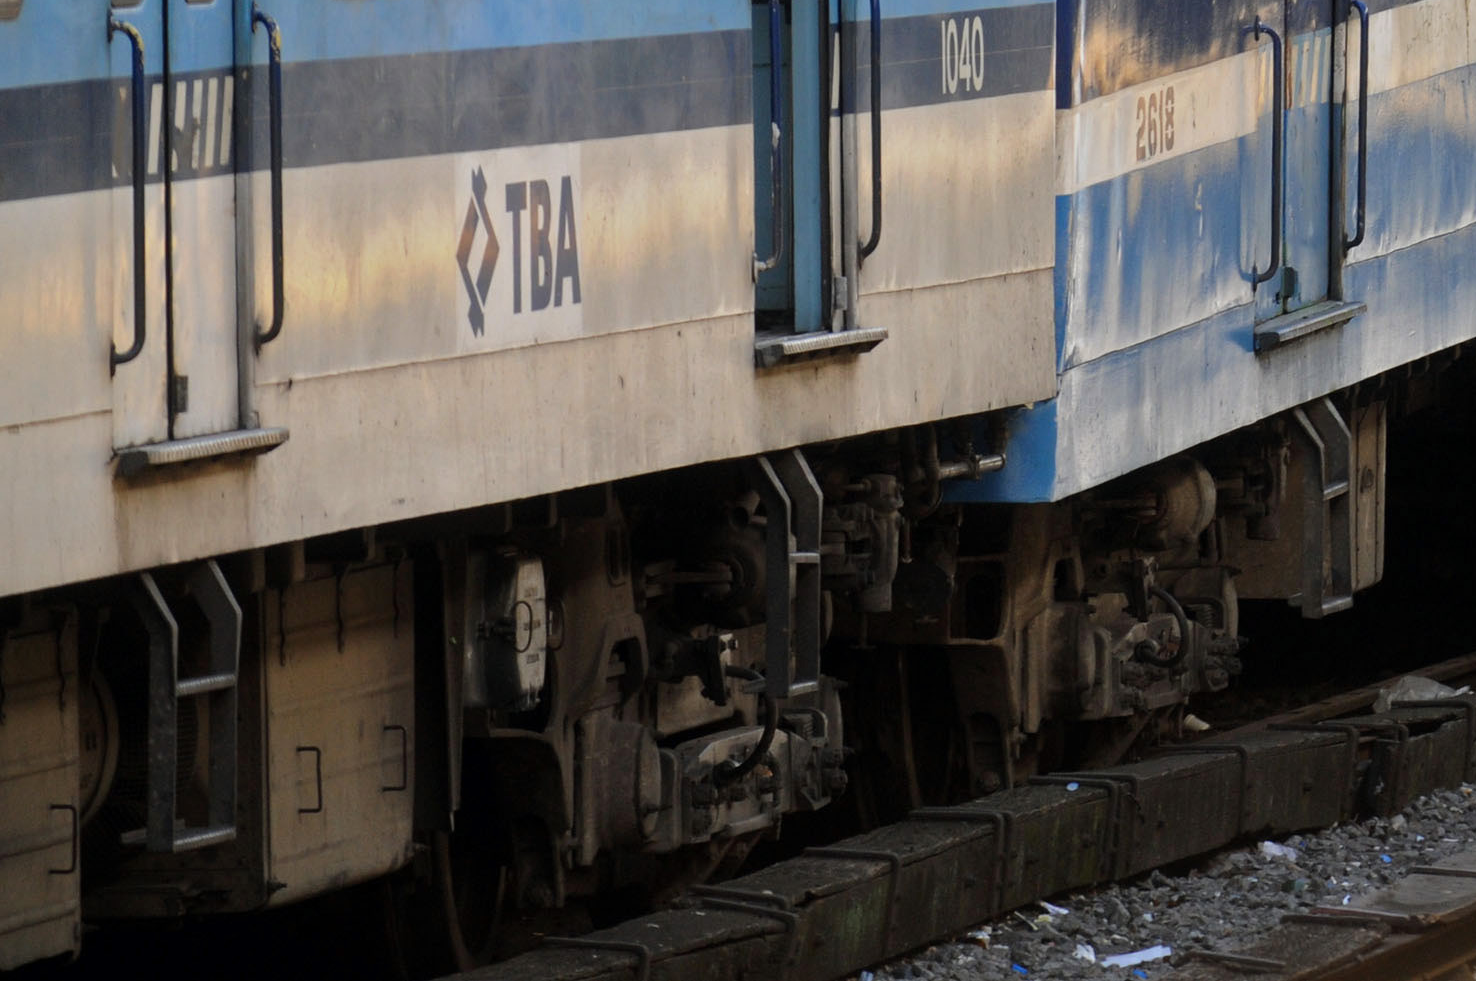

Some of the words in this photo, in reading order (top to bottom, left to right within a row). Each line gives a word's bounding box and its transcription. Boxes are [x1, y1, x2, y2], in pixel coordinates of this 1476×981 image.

[941, 15, 984, 95] 1040
[1136, 85, 1175, 161] 2618
[505, 175, 581, 314] TBA
